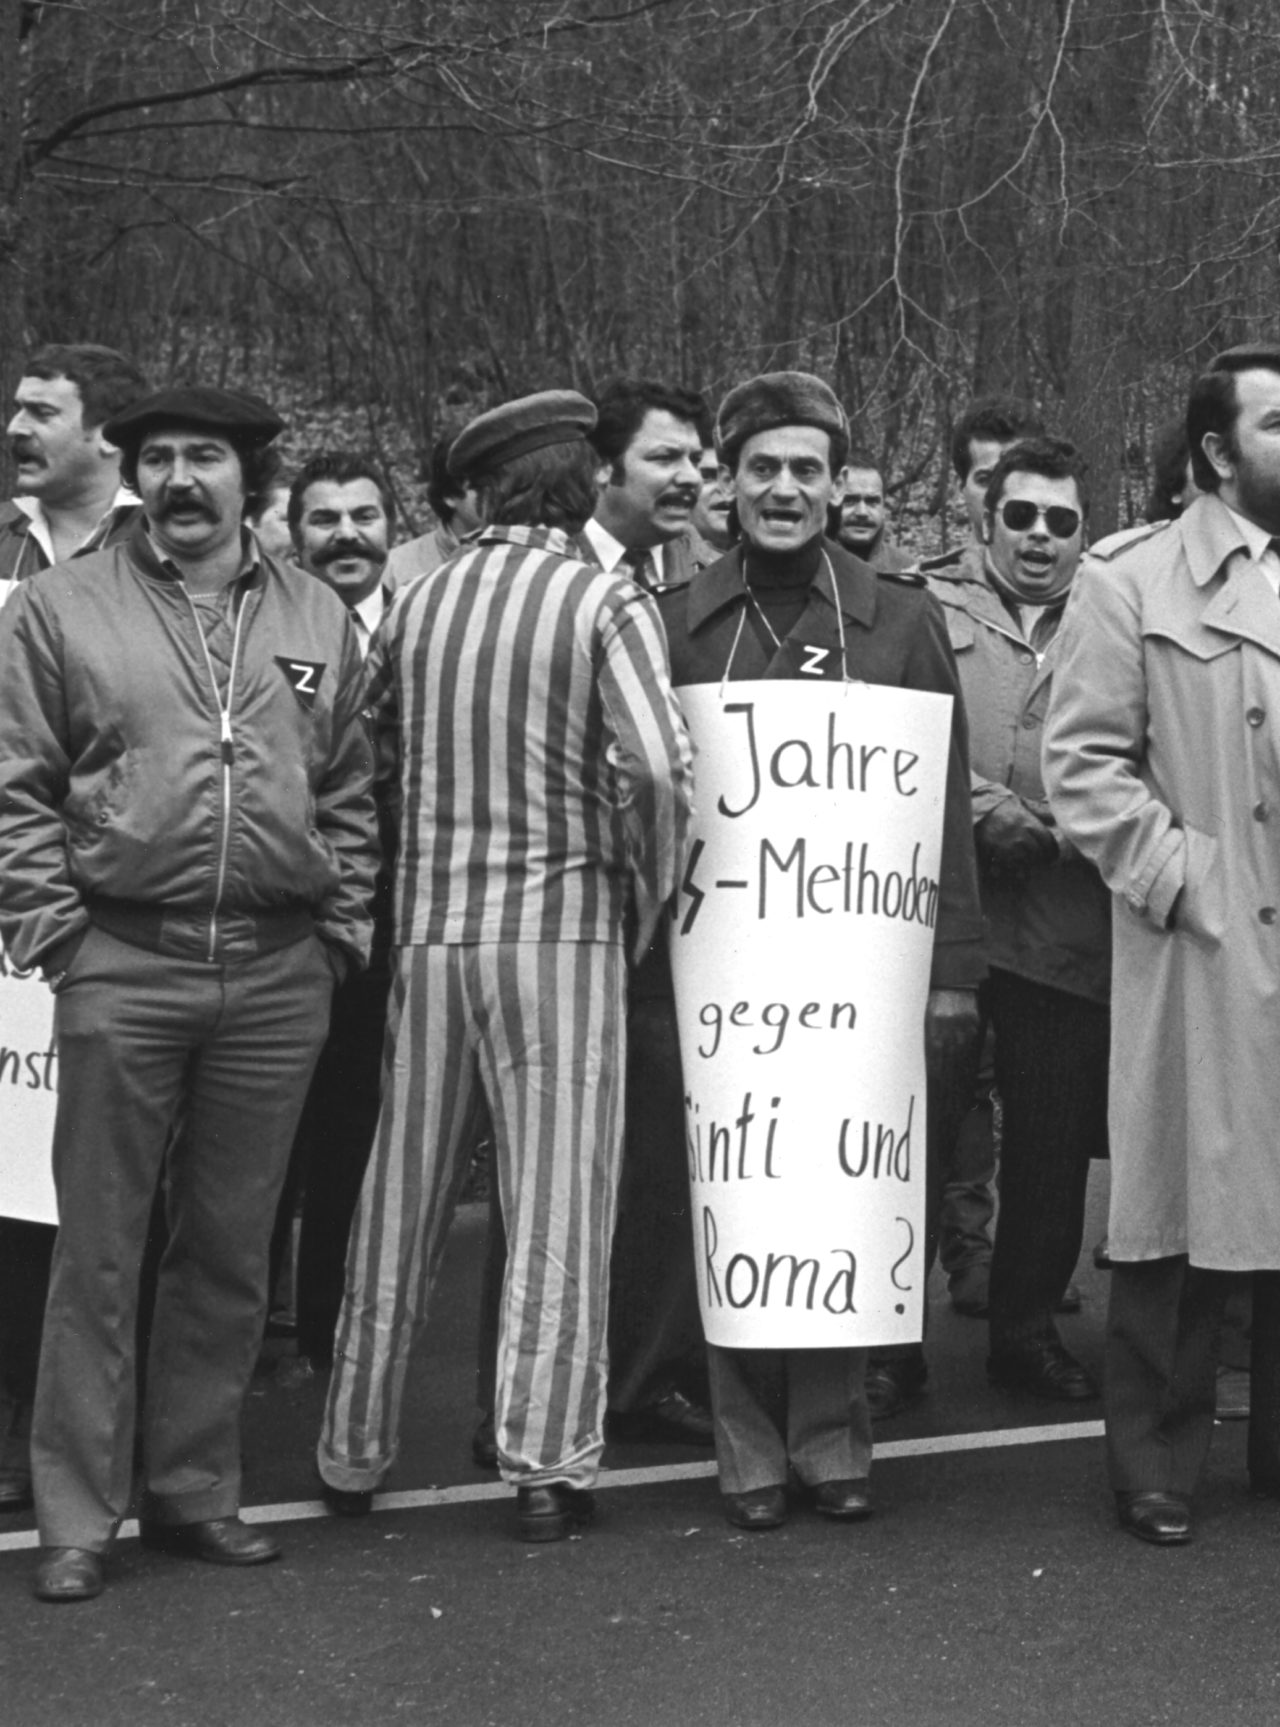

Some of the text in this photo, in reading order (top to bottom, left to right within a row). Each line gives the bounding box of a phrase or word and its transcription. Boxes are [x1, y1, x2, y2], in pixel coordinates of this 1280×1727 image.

[289, 663, 316, 695] Z
[799, 645, 830, 676] Z
[717, 702, 920, 819] Jahre
[698, 1000, 857, 1059] gegen
[838, 1093, 916, 1183] und
